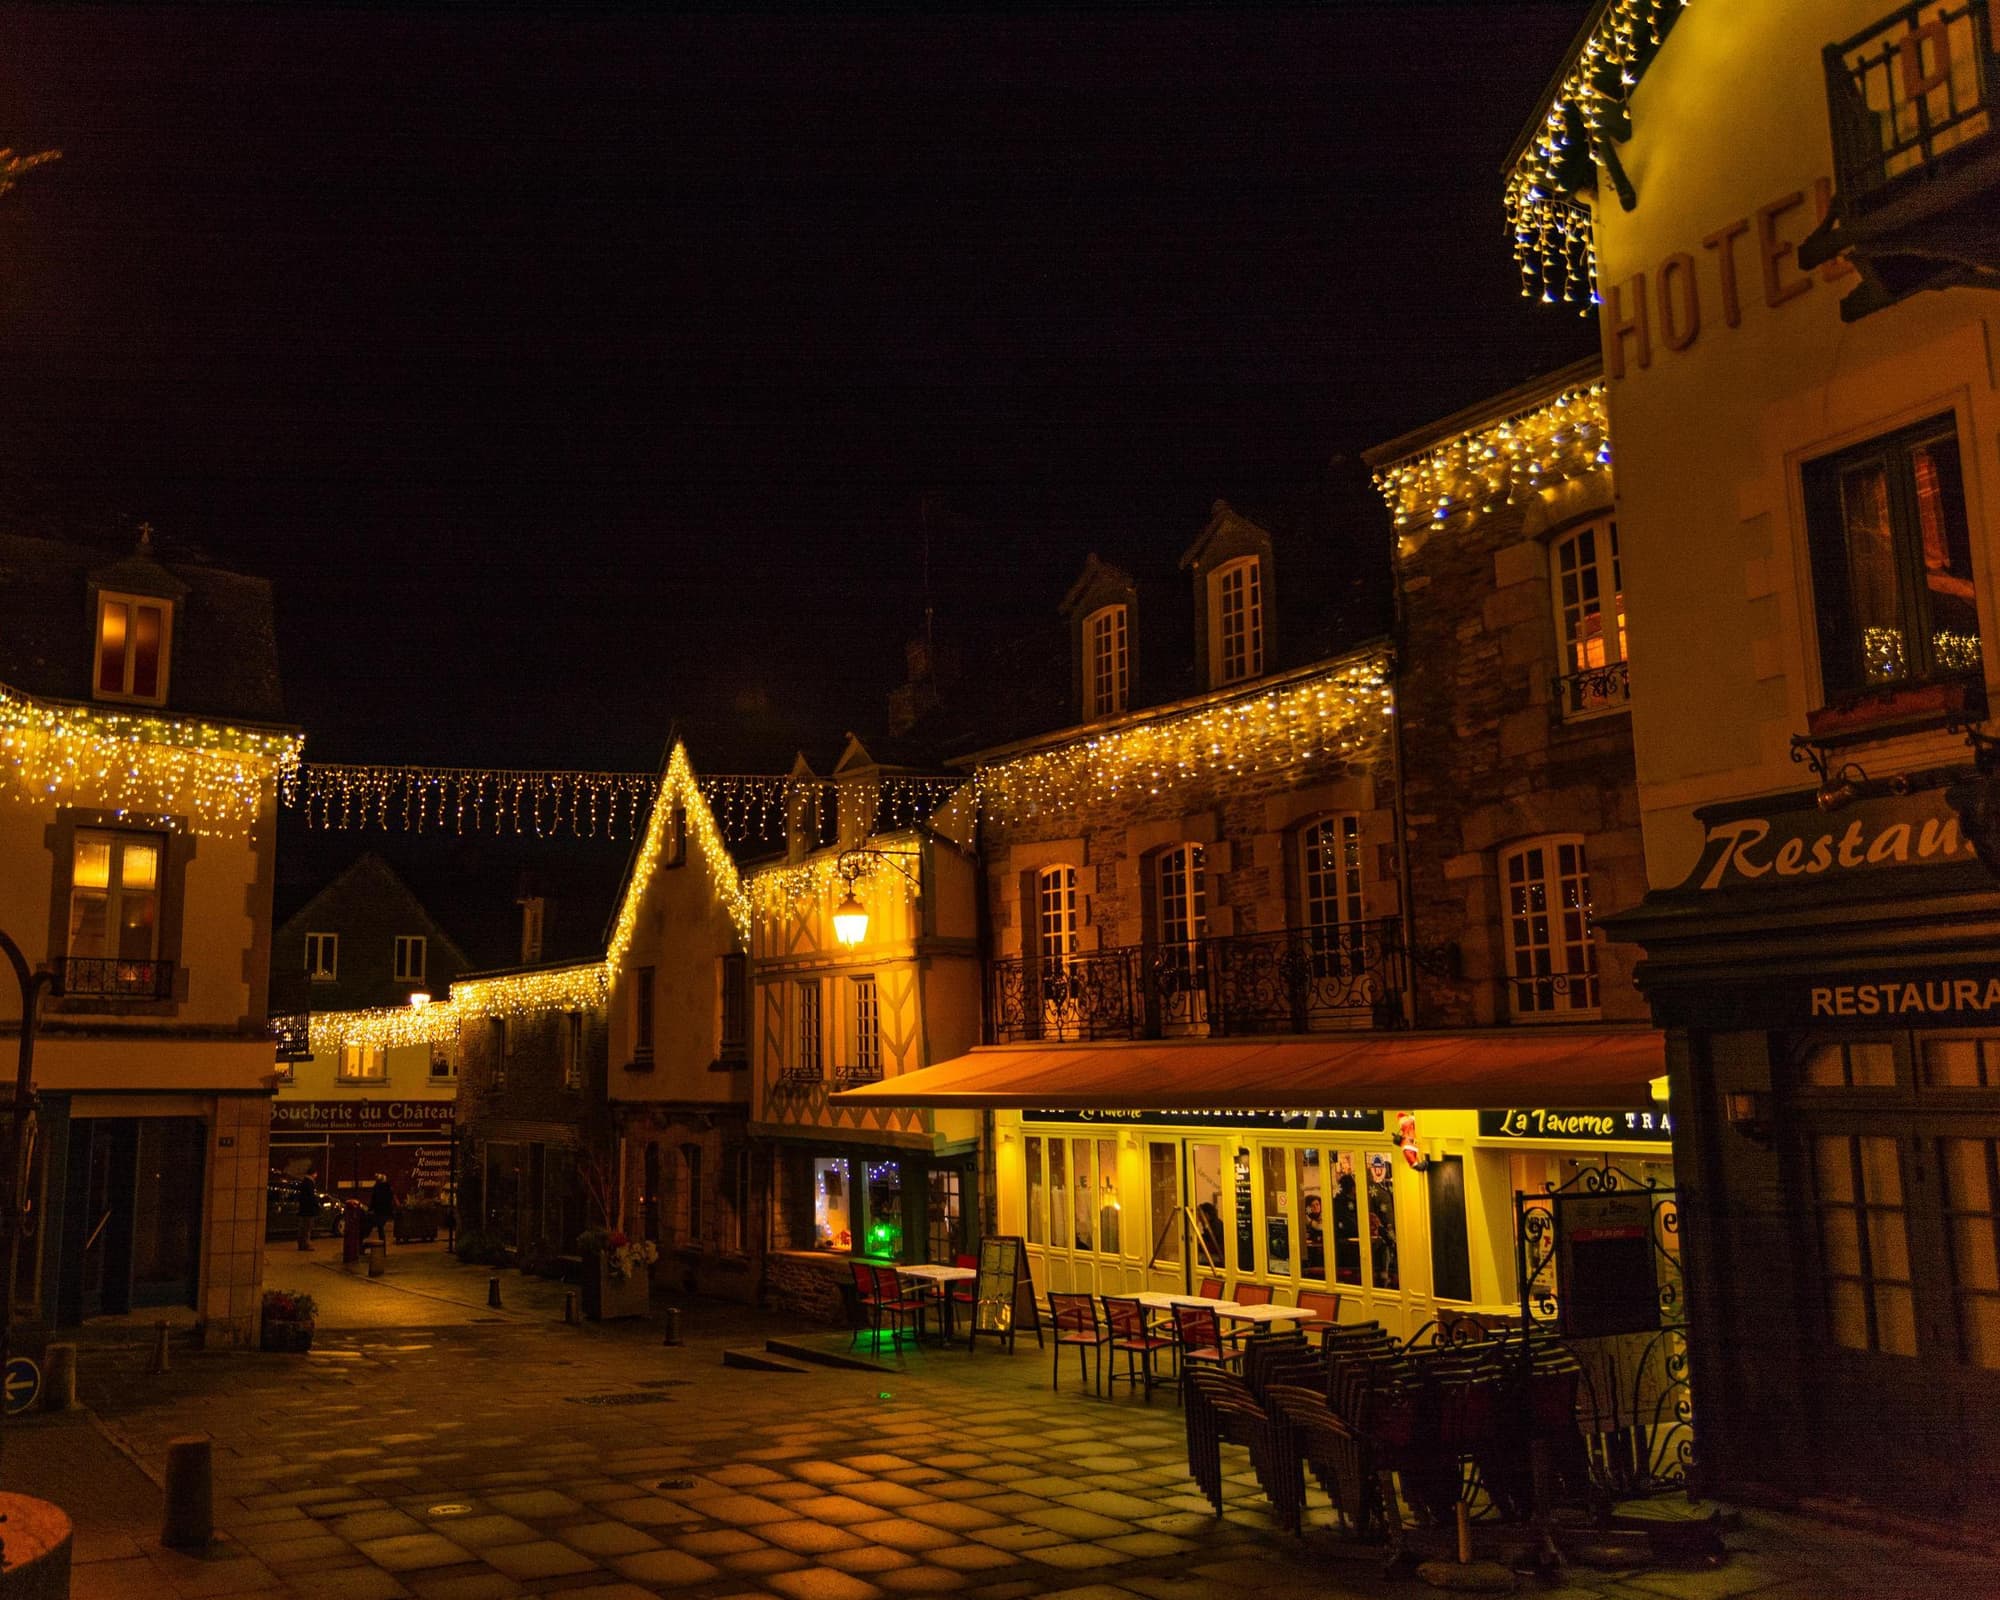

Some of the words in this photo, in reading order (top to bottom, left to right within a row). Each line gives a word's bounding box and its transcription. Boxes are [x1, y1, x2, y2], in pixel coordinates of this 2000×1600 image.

[1700, 816, 1978, 890] Restau
[360, 1103, 381, 1120] du
[1500, 1109, 1528, 1137] La
[1531, 1108, 1614, 1135] Taverne
